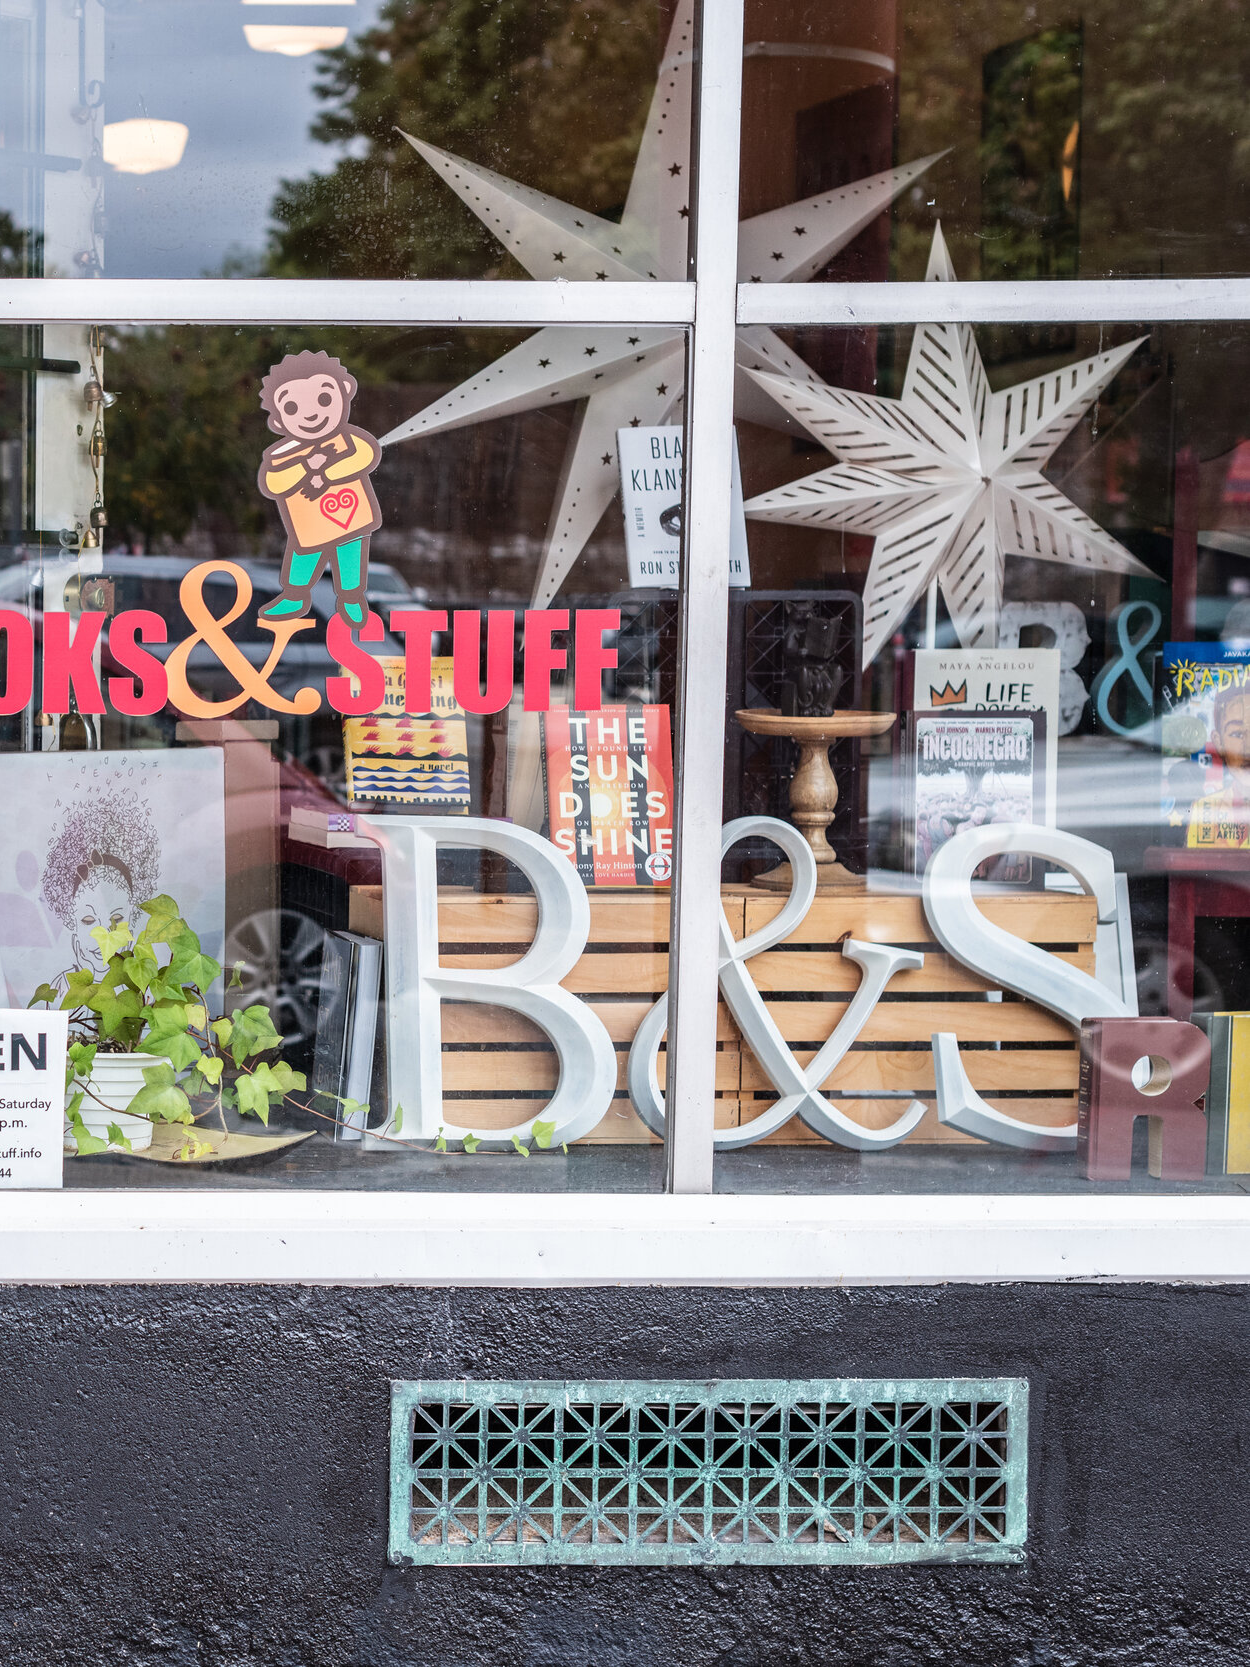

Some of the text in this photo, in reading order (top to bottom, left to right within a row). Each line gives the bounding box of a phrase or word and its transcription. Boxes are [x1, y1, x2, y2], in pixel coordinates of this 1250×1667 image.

[651, 436, 683, 459] BLA
[631, 468, 685, 492] KLANS
[640, 561, 663, 575] RON
[939, 662, 1035, 671] MAYA ANGELOU
[985, 682, 1035, 703] LIFE
[568, 717, 648, 745] THE
[946, 726, 969, 734] JOHNSON
[975, 726, 995, 734] WARREN
[923, 735, 1028, 761] INCOGNEGRO
[428, 763, 454, 771] novel
[570, 754, 649, 782] SUN
[559, 791, 666, 819] DOES
[1216, 830, 1245, 840] ARTIST
[1217, 822, 1246, 830] YOUNG
[555, 828, 673, 856] SHINE
[573, 861, 643, 873] hony Ray Hinton
